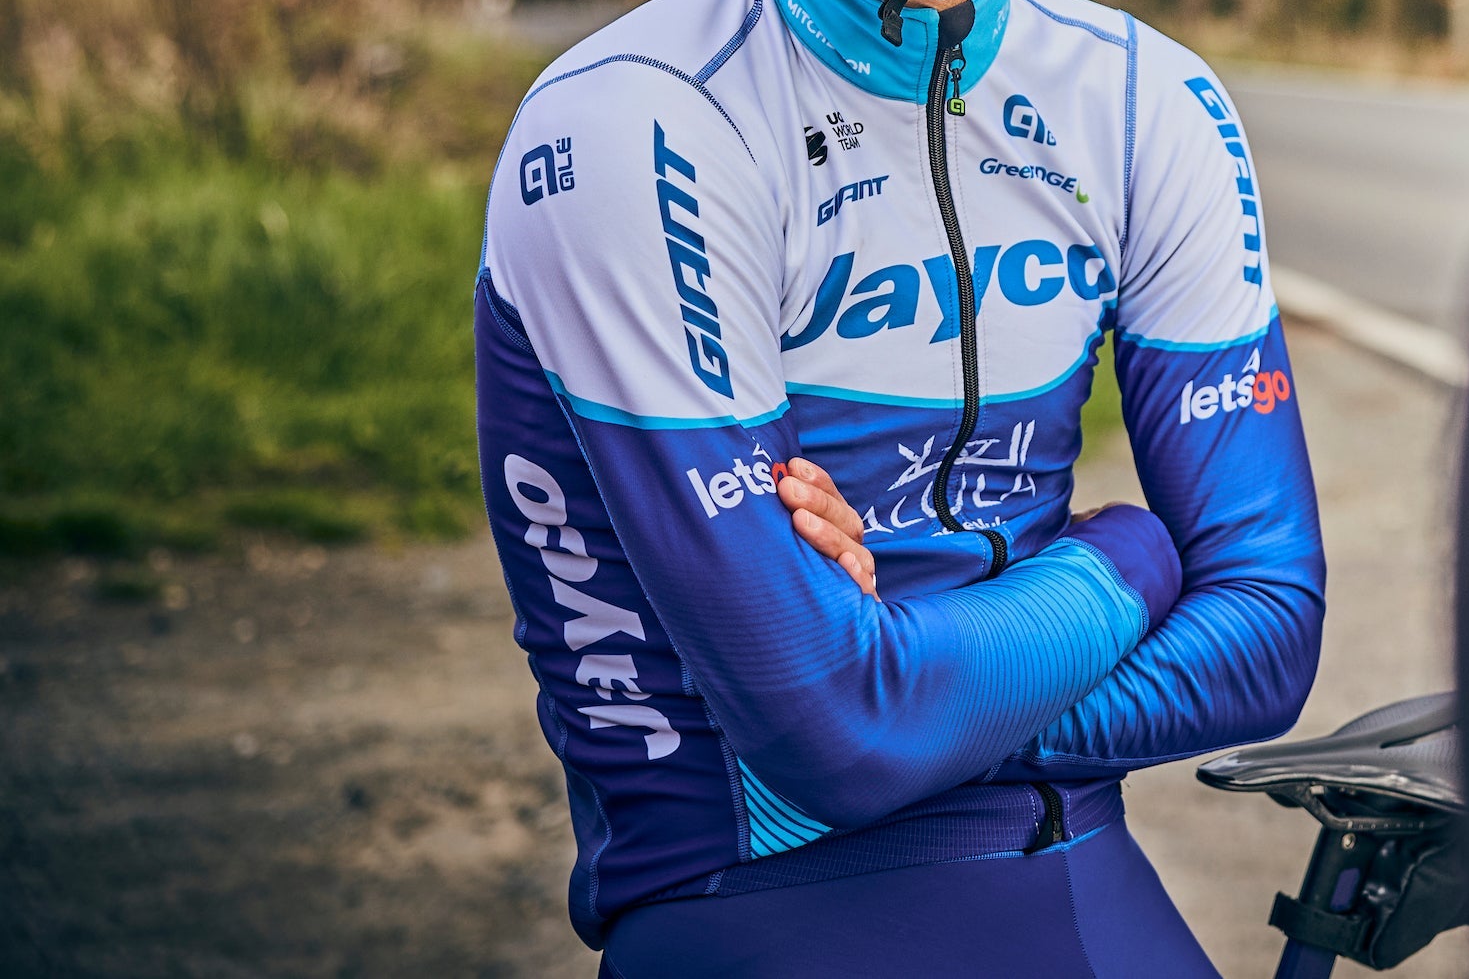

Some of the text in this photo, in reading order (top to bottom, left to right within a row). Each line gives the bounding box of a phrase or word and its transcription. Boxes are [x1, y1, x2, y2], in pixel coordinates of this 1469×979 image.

[832, 122, 864, 139] WORLD
[838, 136, 861, 151] TEAM
[1184, 76, 1263, 290] GIANT
[816, 175, 890, 227] GIANT
[654, 118, 734, 400] GIANT
[780, 239, 1118, 352] Jayco
[503, 453, 681, 761] Jayco
